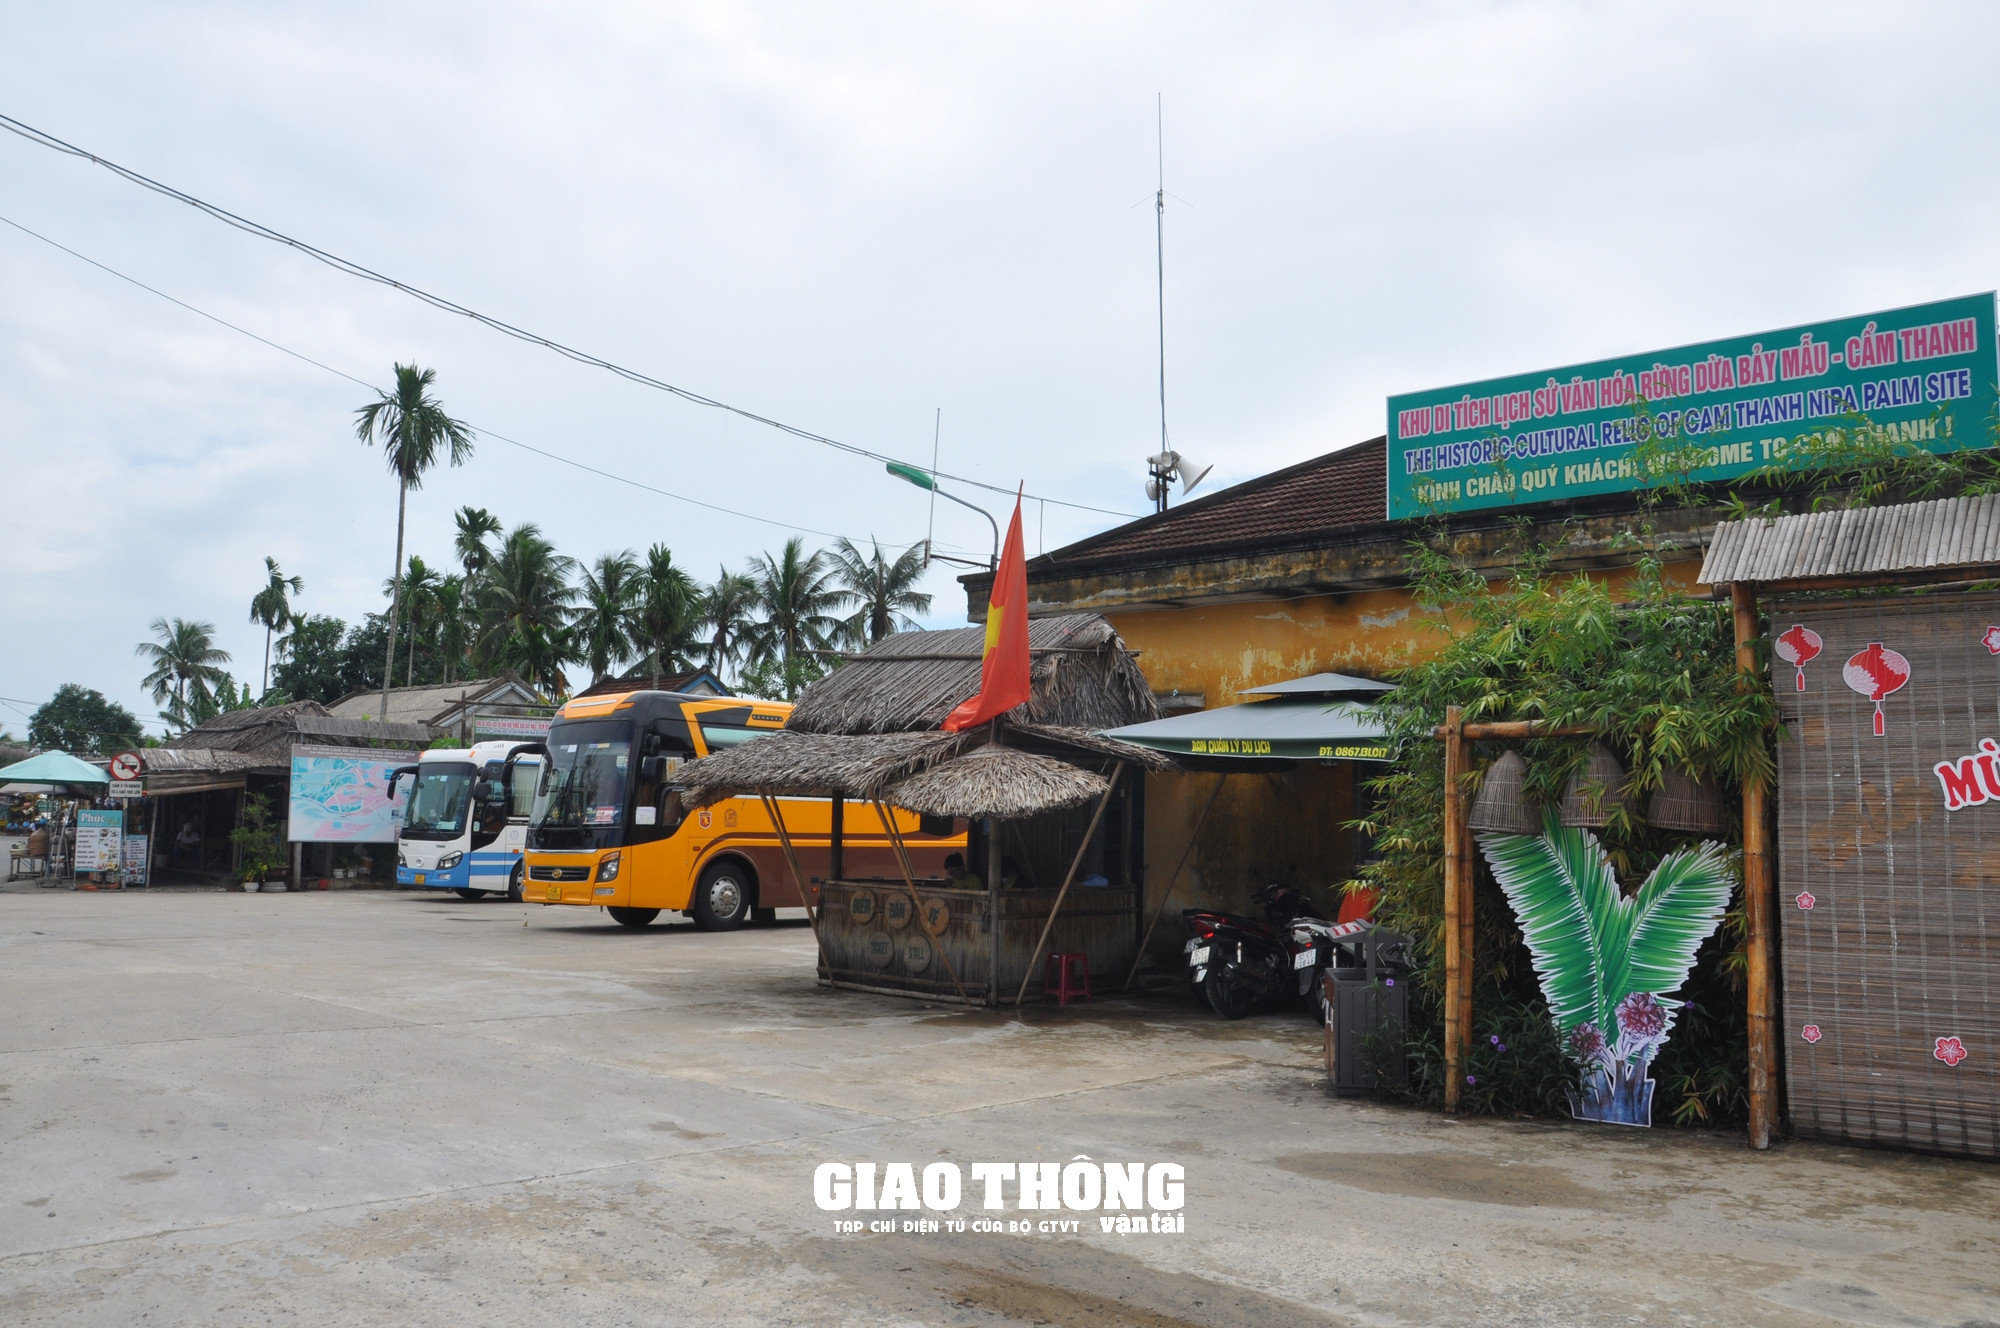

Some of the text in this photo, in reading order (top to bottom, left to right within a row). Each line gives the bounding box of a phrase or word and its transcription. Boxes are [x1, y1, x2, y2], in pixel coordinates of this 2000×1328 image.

[1399, 406, 1432, 439] KHU
[1433, 402, 1451, 434] DI
[1453, 394, 1491, 431] TÍCH
[1493, 390, 1532, 430] LỊCH
[1533, 376, 1560, 419] SỬ
[1561, 376, 1597, 415] VĂN
[1600, 369, 1637, 409] HÓA
[1640, 363, 1690, 404] RỪNG
[1694, 354, 1735, 393] DỪA
[1737, 342, 1778, 387] BẢY
[1780, 332, 1829, 381] MẪU
[1845, 321, 1898, 371] CẨM
[1898, 316, 1977, 363] THANH
[1404, 447, 1433, 475] THE
[1435, 422, 1599, 470] HISTORIC-CULTURAL
[1654, 410, 1682, 440] OF
[1684, 402, 1732, 436] CAM
[1735, 391, 1804, 430] THANH
[1807, 384, 1860, 419] NIPA
[1862, 374, 1922, 411] PALM
[1926, 367, 1971, 402] SITE
[1466, 471, 1516, 498] CHÀO
[1522, 464, 1558, 492] QUÝ
[1760, 437, 1787, 460] TO
[1191, 740, 1207, 753] BAN
[1230, 738, 1240, 753] LÝ
[1241, 741, 1254, 753] DU
[1254, 741, 1271, 756] LỊCH
[81, 812, 106, 823] Phúc
